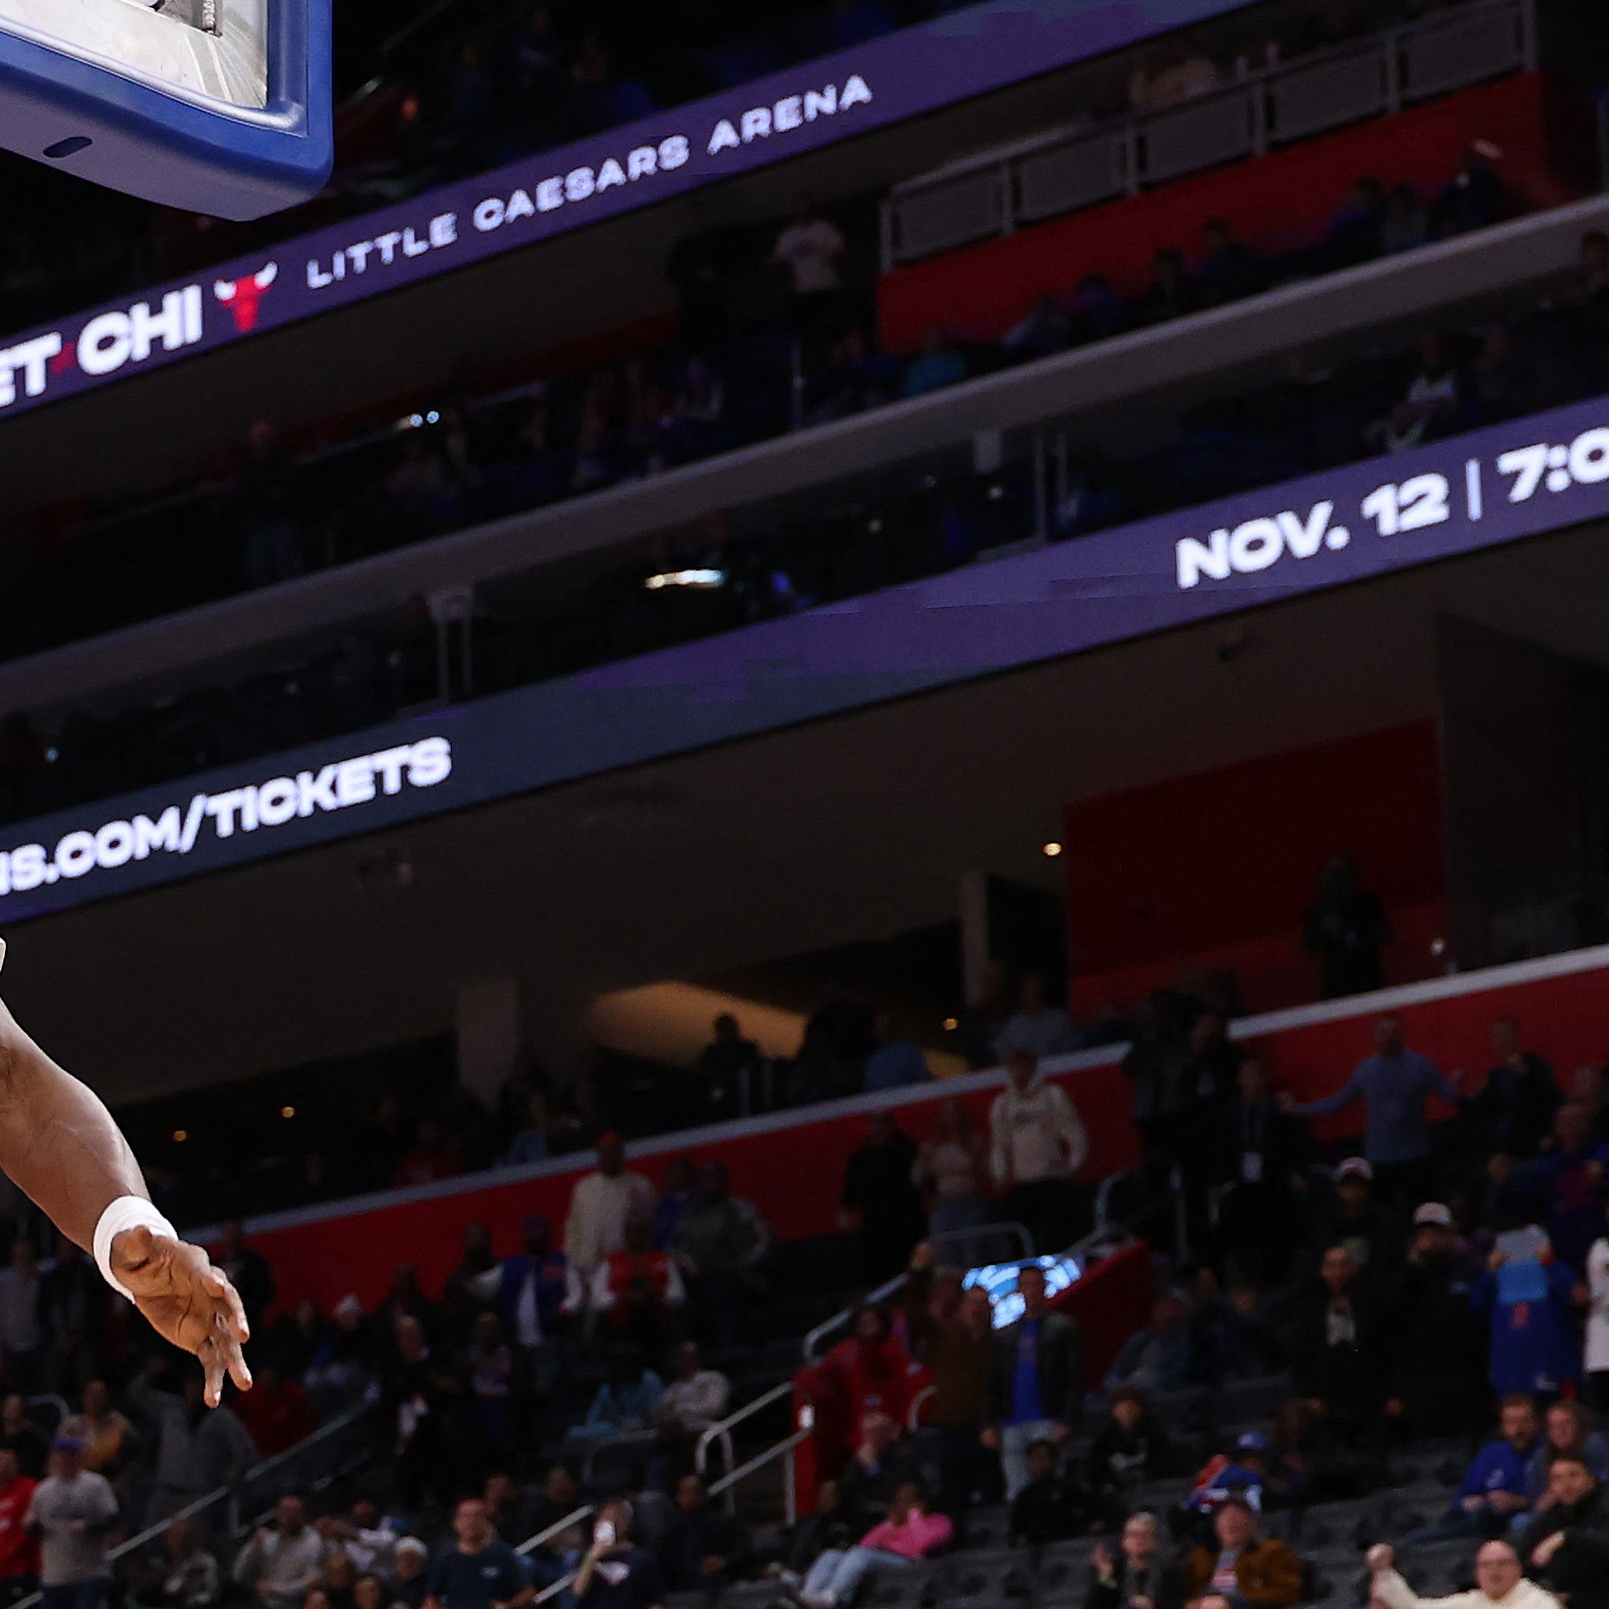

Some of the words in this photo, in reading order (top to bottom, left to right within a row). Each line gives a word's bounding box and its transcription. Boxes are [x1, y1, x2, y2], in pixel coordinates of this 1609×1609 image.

[307, 214, 458, 288] LITTLE
[474, 135, 690, 231] CAESARS
[707, 75, 873, 155] ARENA
[77, 284, 203, 375] CHI
[1176, 500, 1351, 589] NOV.
[1361, 473, 1450, 536] 12
